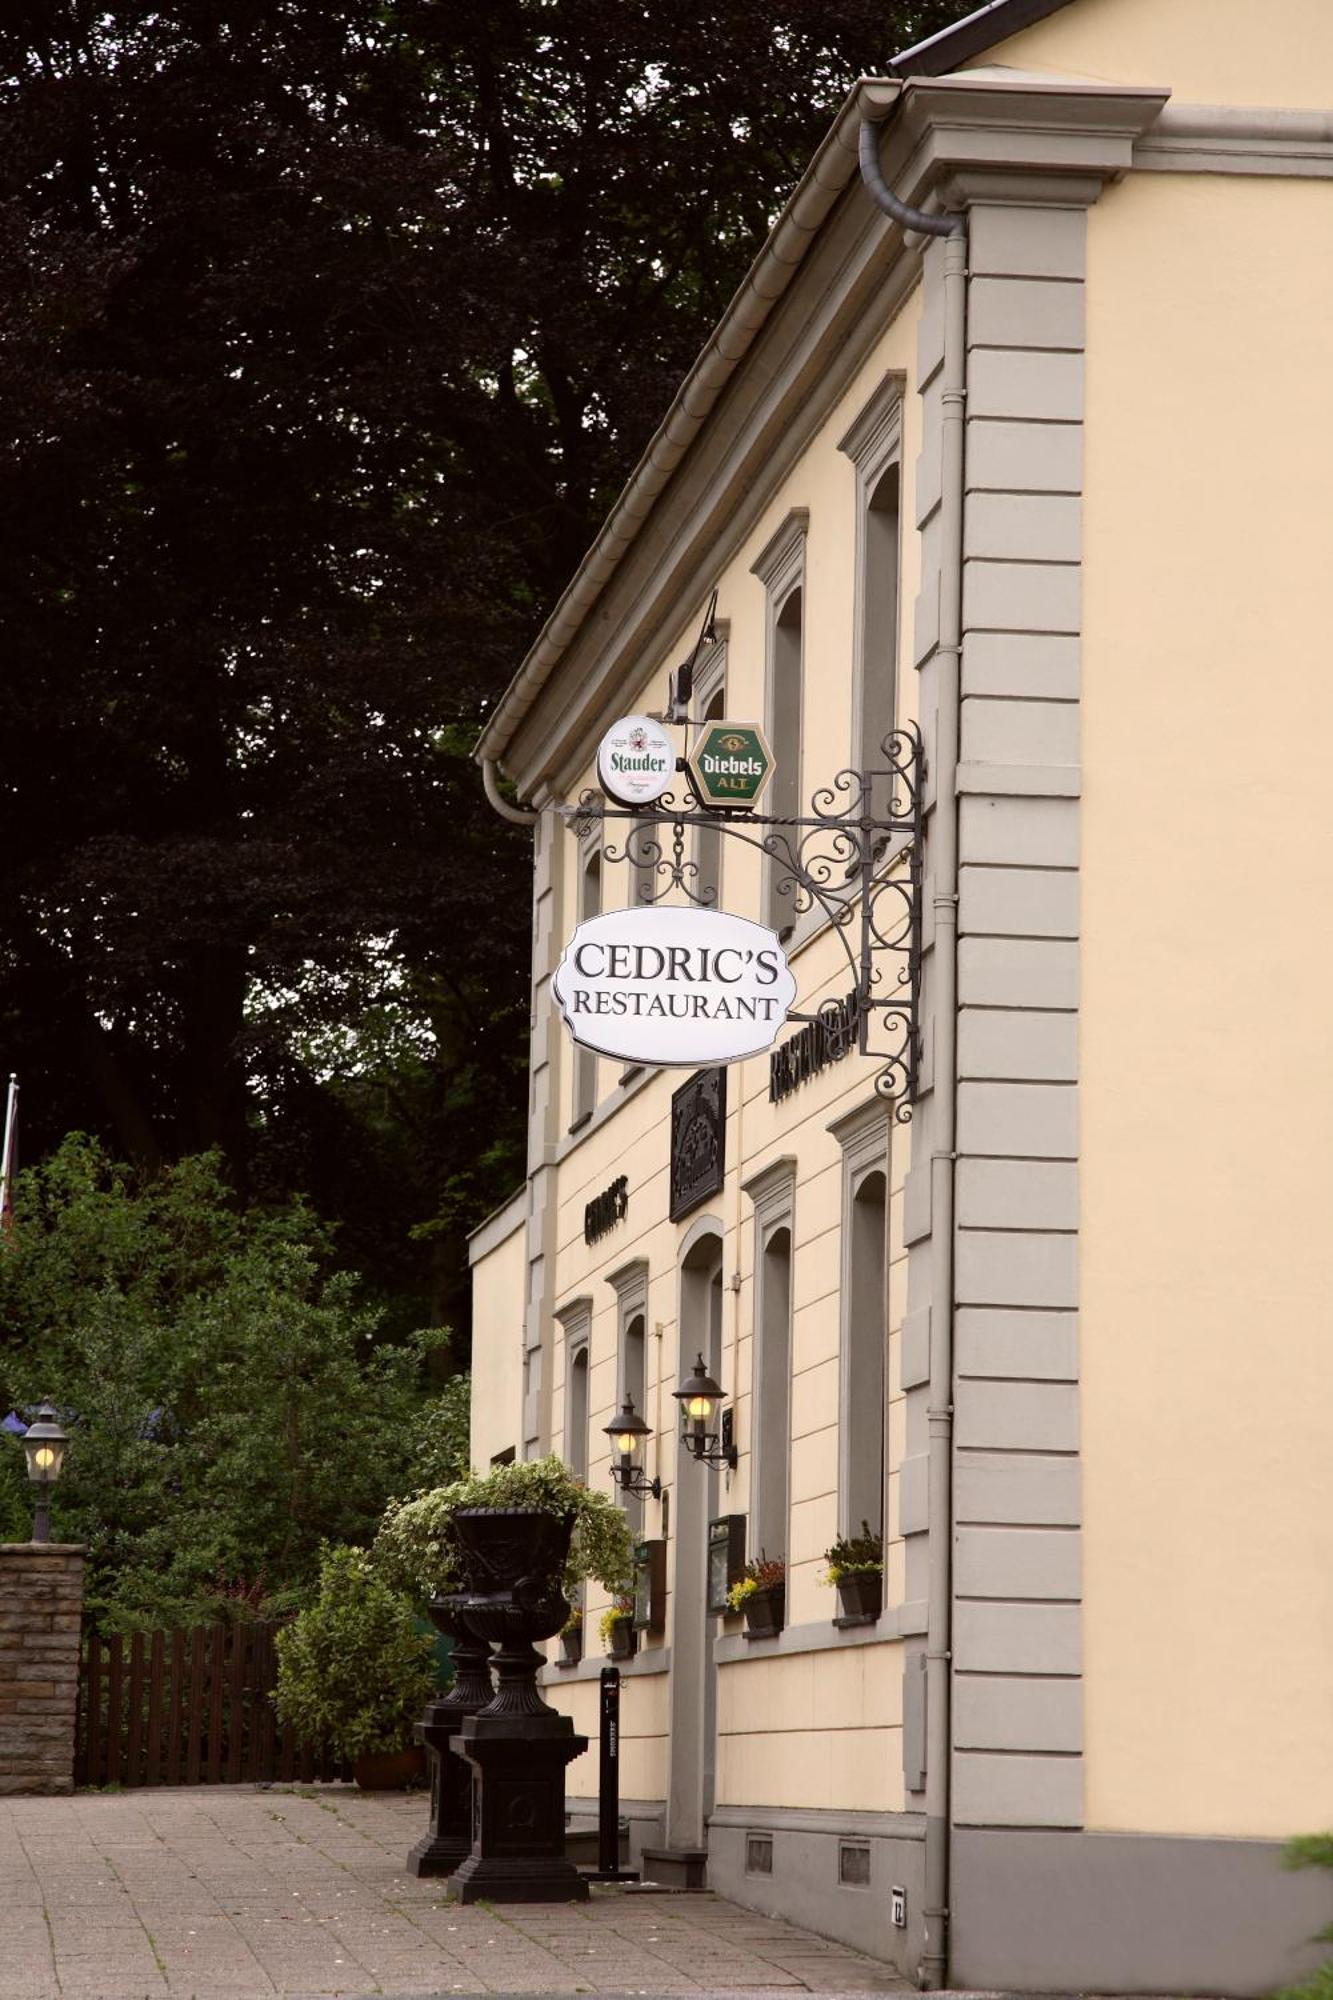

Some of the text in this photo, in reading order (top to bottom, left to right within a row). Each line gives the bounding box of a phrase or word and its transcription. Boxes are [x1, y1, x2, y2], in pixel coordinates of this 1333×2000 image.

[611, 752, 666, 773] Stauder
[703, 754, 762, 775] Diebels
[717, 777, 750, 790] ALT
[574, 943, 778, 985] CEDRIC'S
[573, 990, 779, 1021] RESTAURANT
